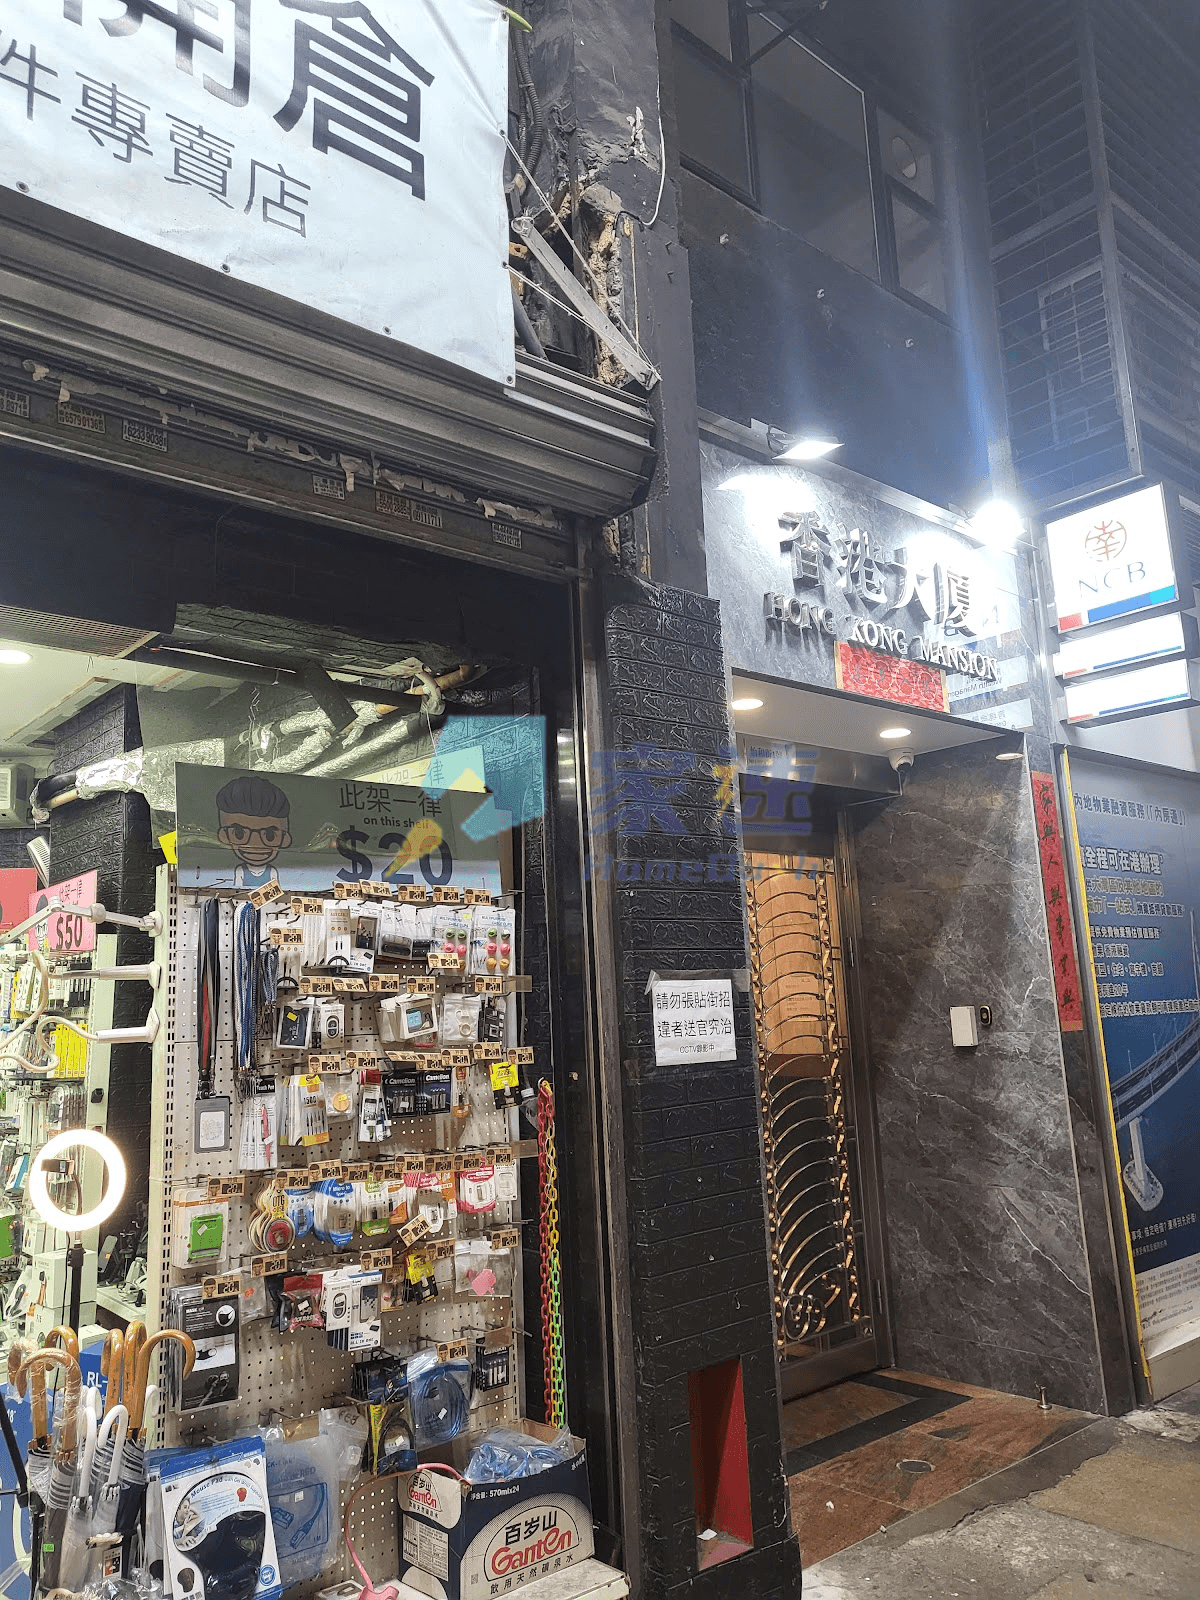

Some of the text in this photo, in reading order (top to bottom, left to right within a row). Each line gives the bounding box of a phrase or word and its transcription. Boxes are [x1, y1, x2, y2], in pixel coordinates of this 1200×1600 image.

[778, 511, 978, 637] 香港大廈
[1078, 561, 1146, 598] NCB
[763, 591, 836, 635] HONG
[851, 616, 909, 655] KONG
[918, 634, 998, 681] MANSION
[340, 783, 443, 818] 此架一律
[363, 816, 430, 830] on this shelf
[336, 824, 453, 886] $20
[56, 914, 83, 951] $50
[656, 991, 731, 1010] 請勿張貼街招
[657, 1018, 732, 1039] 違者送官究治
[272, 1195, 285, 1207] OTG
[190, 1482, 210, 1498] Mouse
[211, 1477, 223, 1486] Pad
[408, 1484, 437, 1509] Ganten
[505, 1511, 557, 1546] 百岁山
[491, 1527, 572, 1576] Ganten
